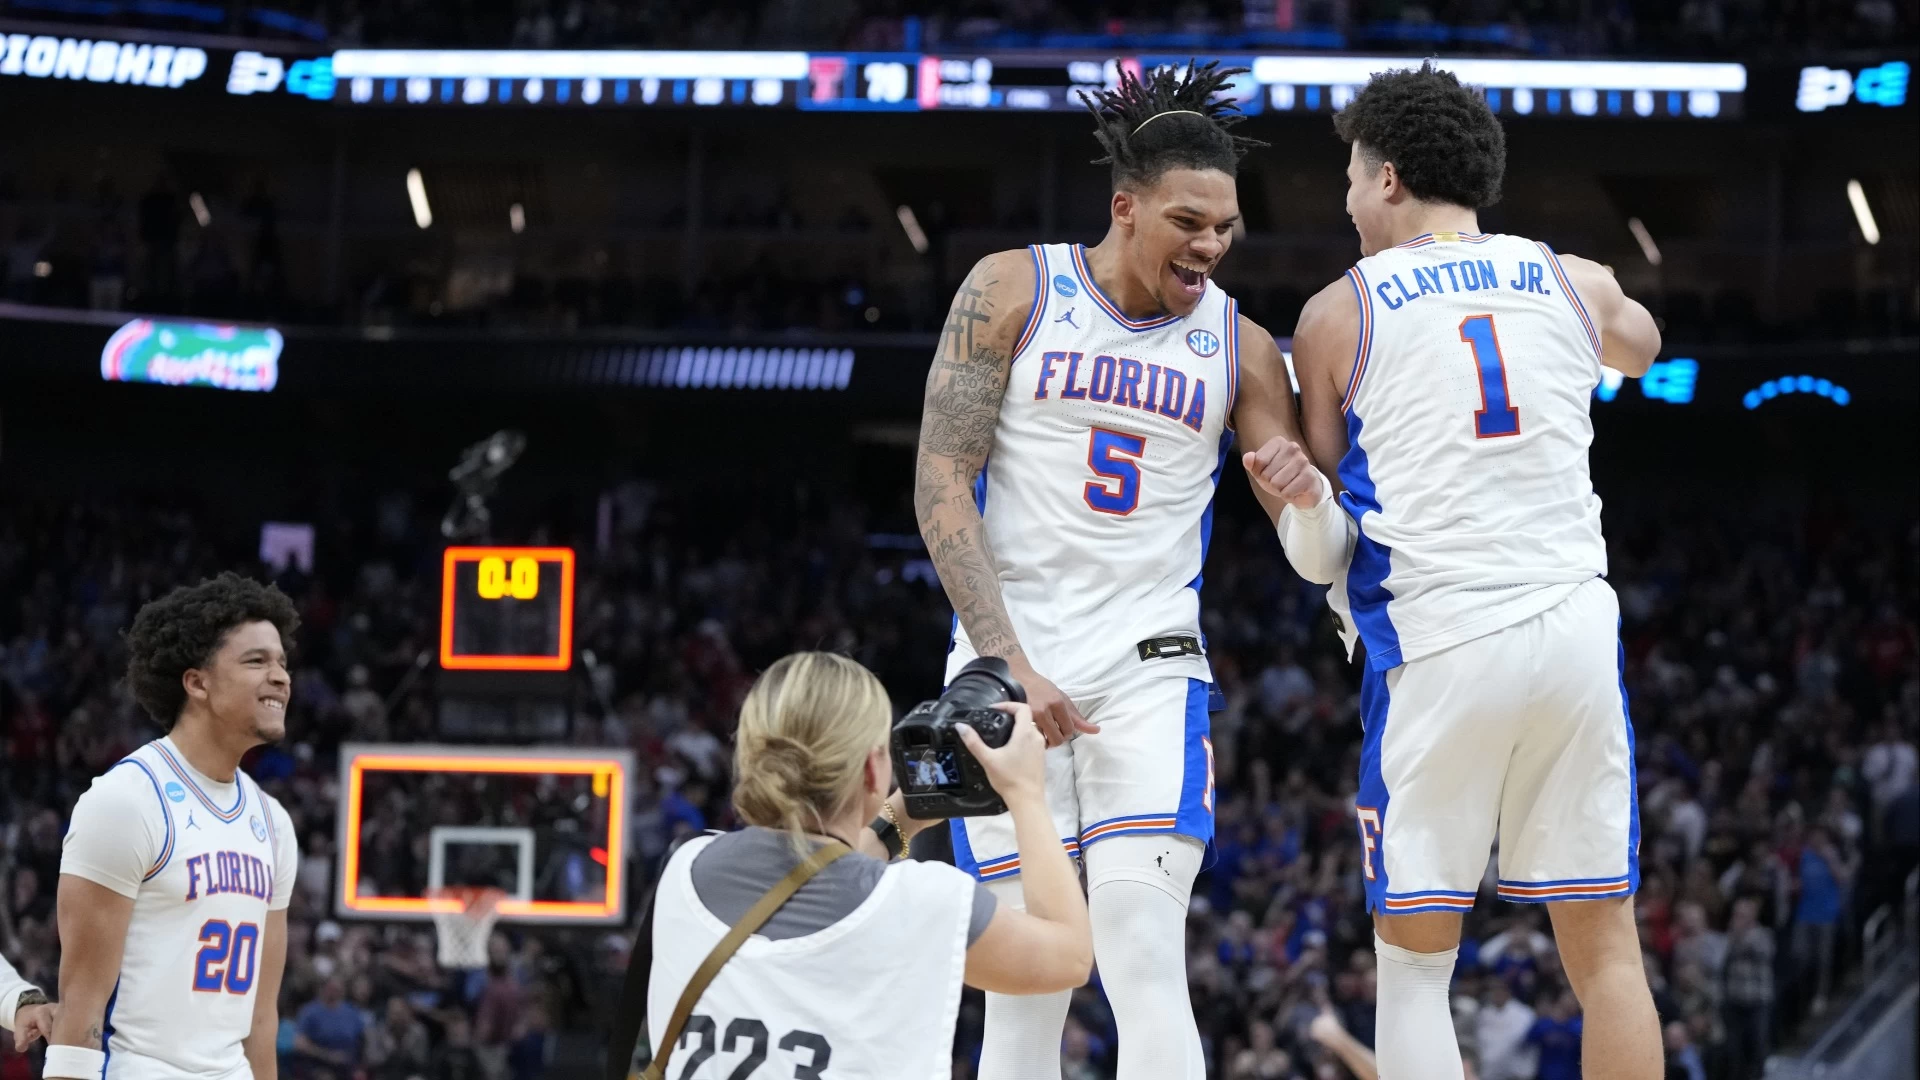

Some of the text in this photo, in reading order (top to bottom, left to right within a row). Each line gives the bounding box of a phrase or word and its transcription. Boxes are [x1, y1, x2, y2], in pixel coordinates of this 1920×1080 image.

[0, 33, 208, 88] IONSHIP
[1376, 260, 1551, 310] CLAYTON JR.
[1189, 331, 1218, 355] SEC
[1034, 351, 1206, 433] FLORIDA
[1458, 314, 1520, 439] 1
[1083, 427, 1146, 517] 5
[478, 556, 539, 599] 0.0
[192, 918, 259, 995] 20
[678, 1015, 832, 1080] 223
